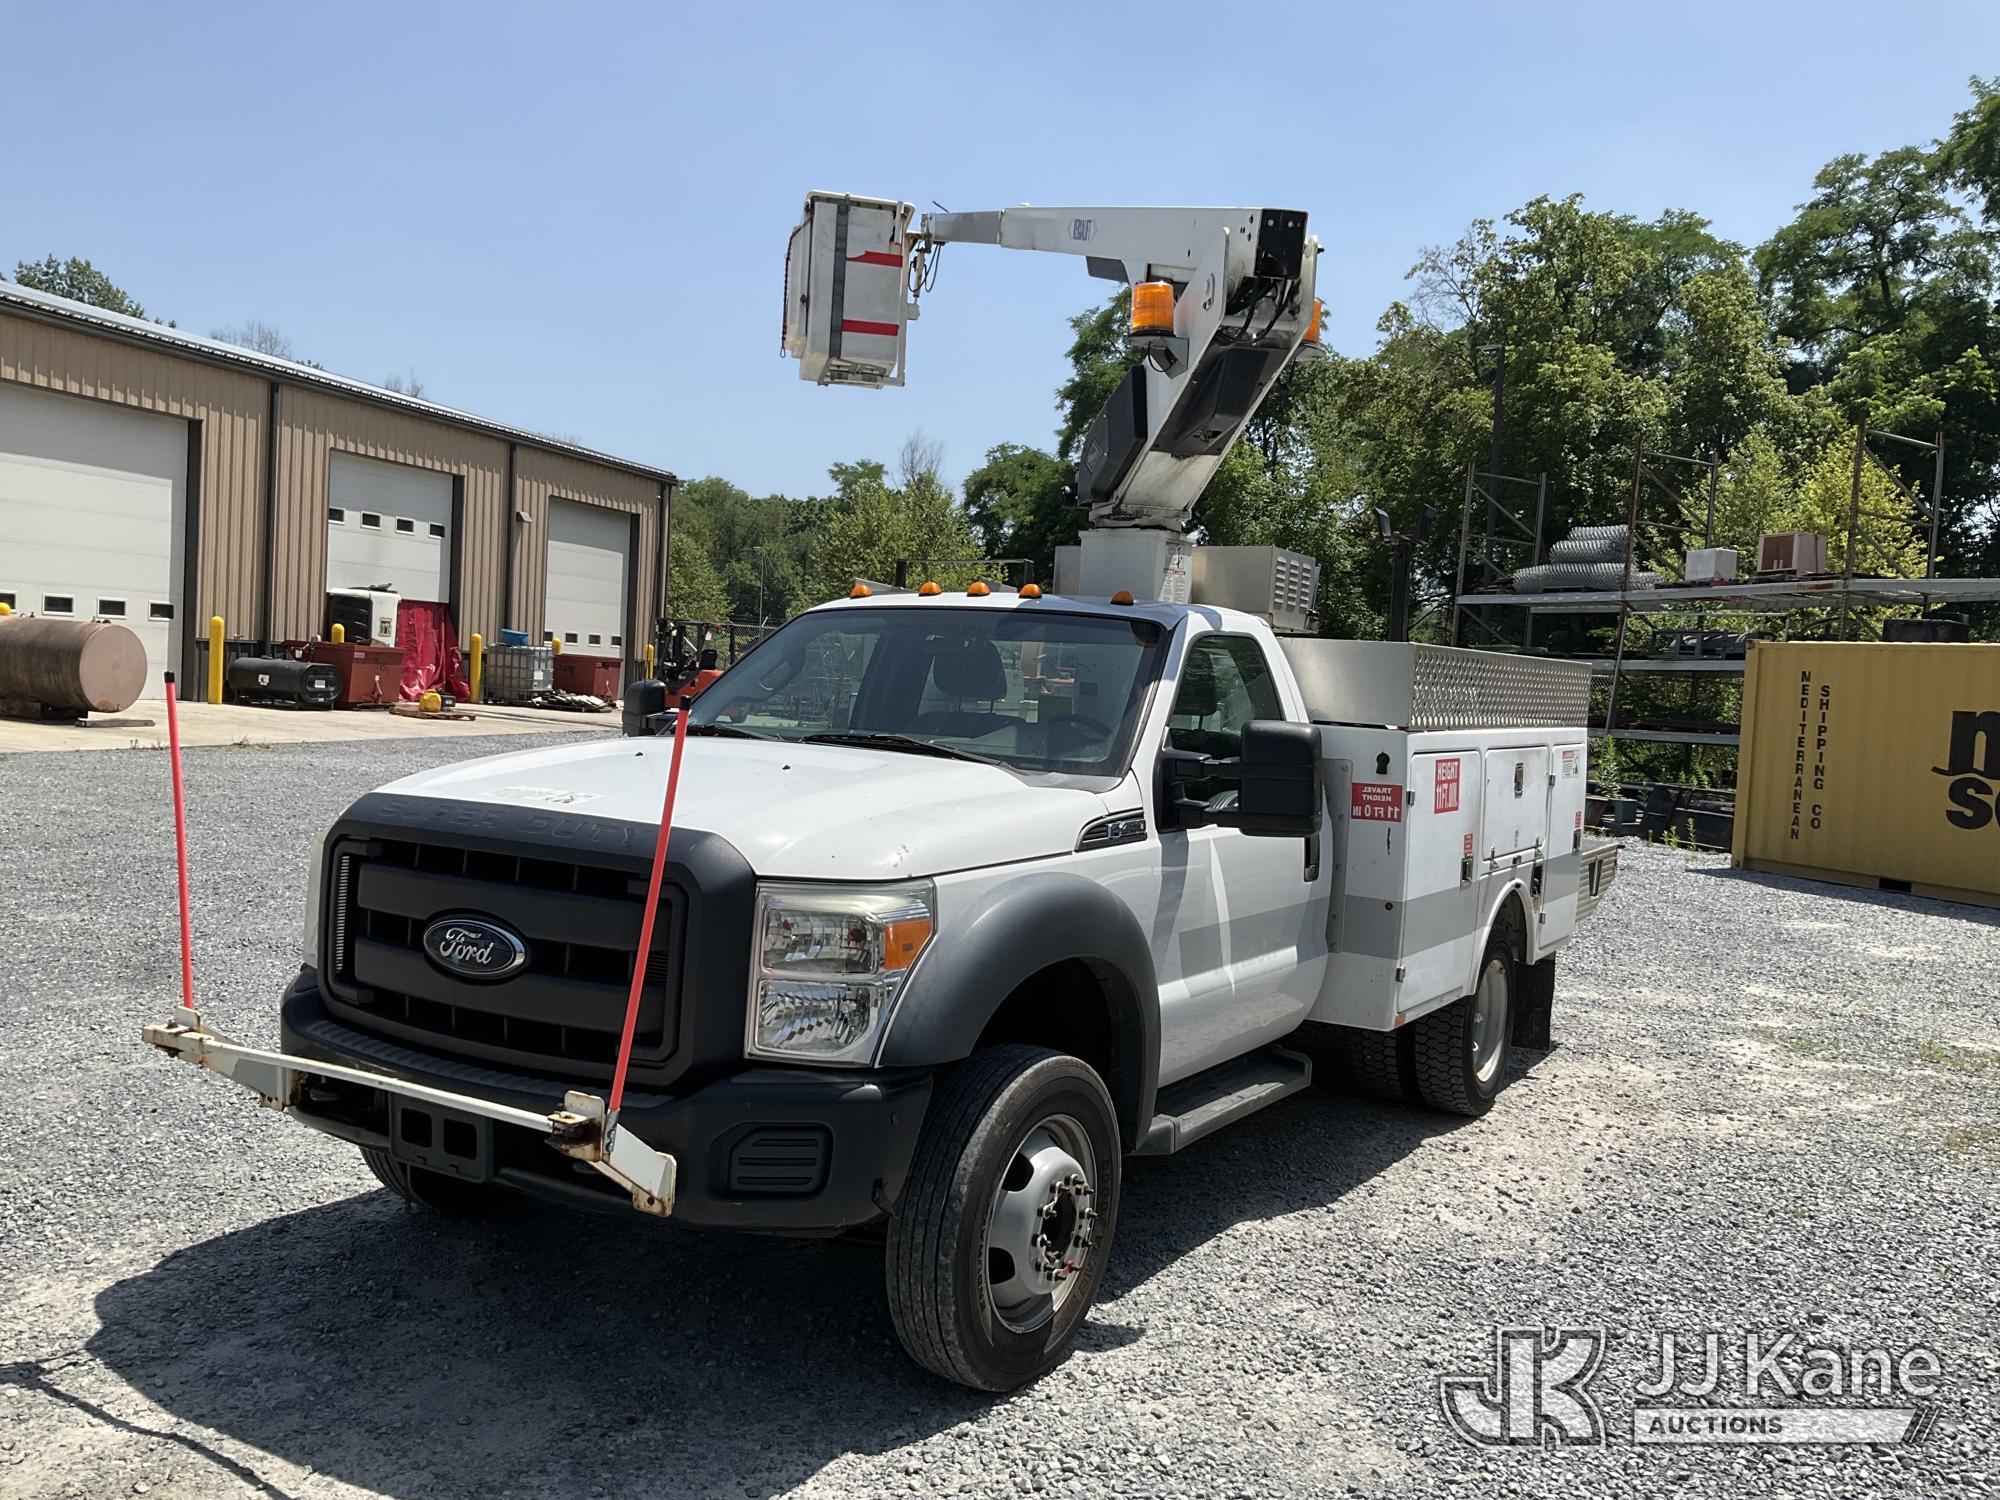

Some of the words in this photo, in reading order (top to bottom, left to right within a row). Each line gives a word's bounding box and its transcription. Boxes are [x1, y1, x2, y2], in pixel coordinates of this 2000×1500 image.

[1790, 671, 1812, 840] MEDITERRANEAN
[1813, 685, 1831, 790] SHIPPING
[1437, 761, 1458, 781] HEIGHT
[378, 802, 507, 829] SUPER
[519, 815, 634, 848] DUTY
[1811, 804, 1822, 829] CO
[440, 926, 494, 965] Ford
